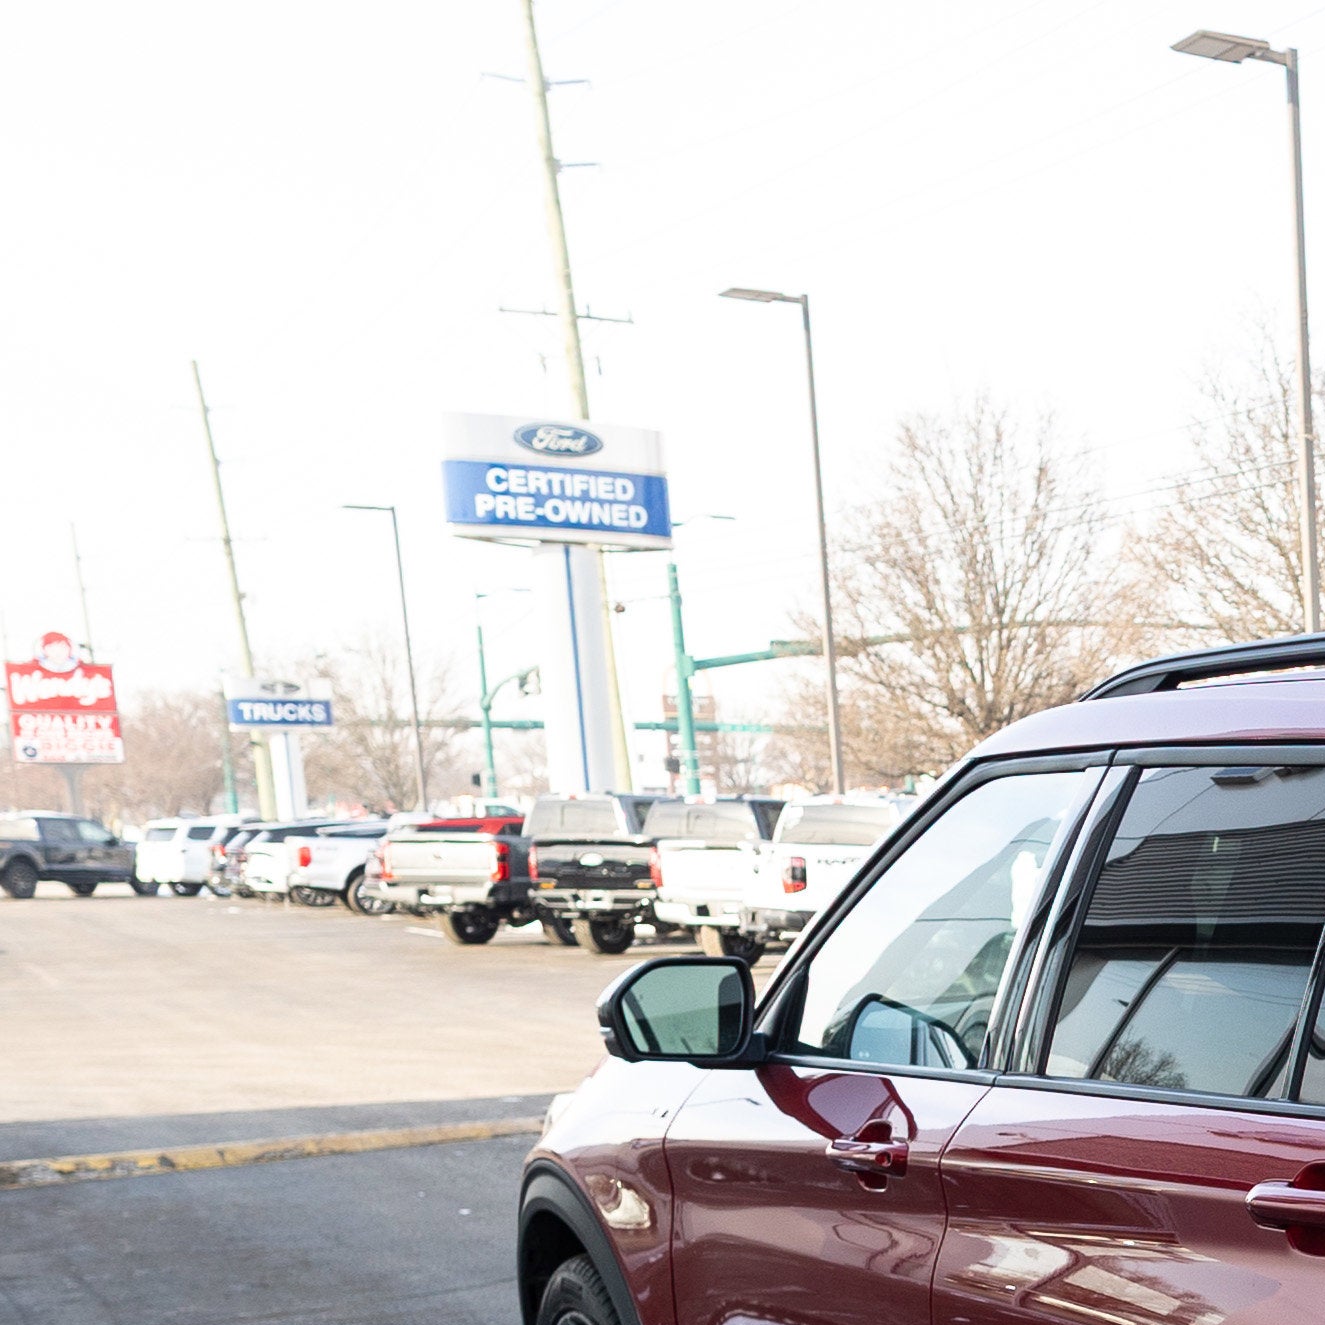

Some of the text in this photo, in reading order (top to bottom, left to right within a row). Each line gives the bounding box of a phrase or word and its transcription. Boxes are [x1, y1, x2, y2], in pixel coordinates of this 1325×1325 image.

[530, 426, 590, 453] Ford
[485, 467, 635, 501] CERTIFIED
[474, 493, 649, 528] PRE-OWNED
[238, 701, 326, 722] TRUCKS
